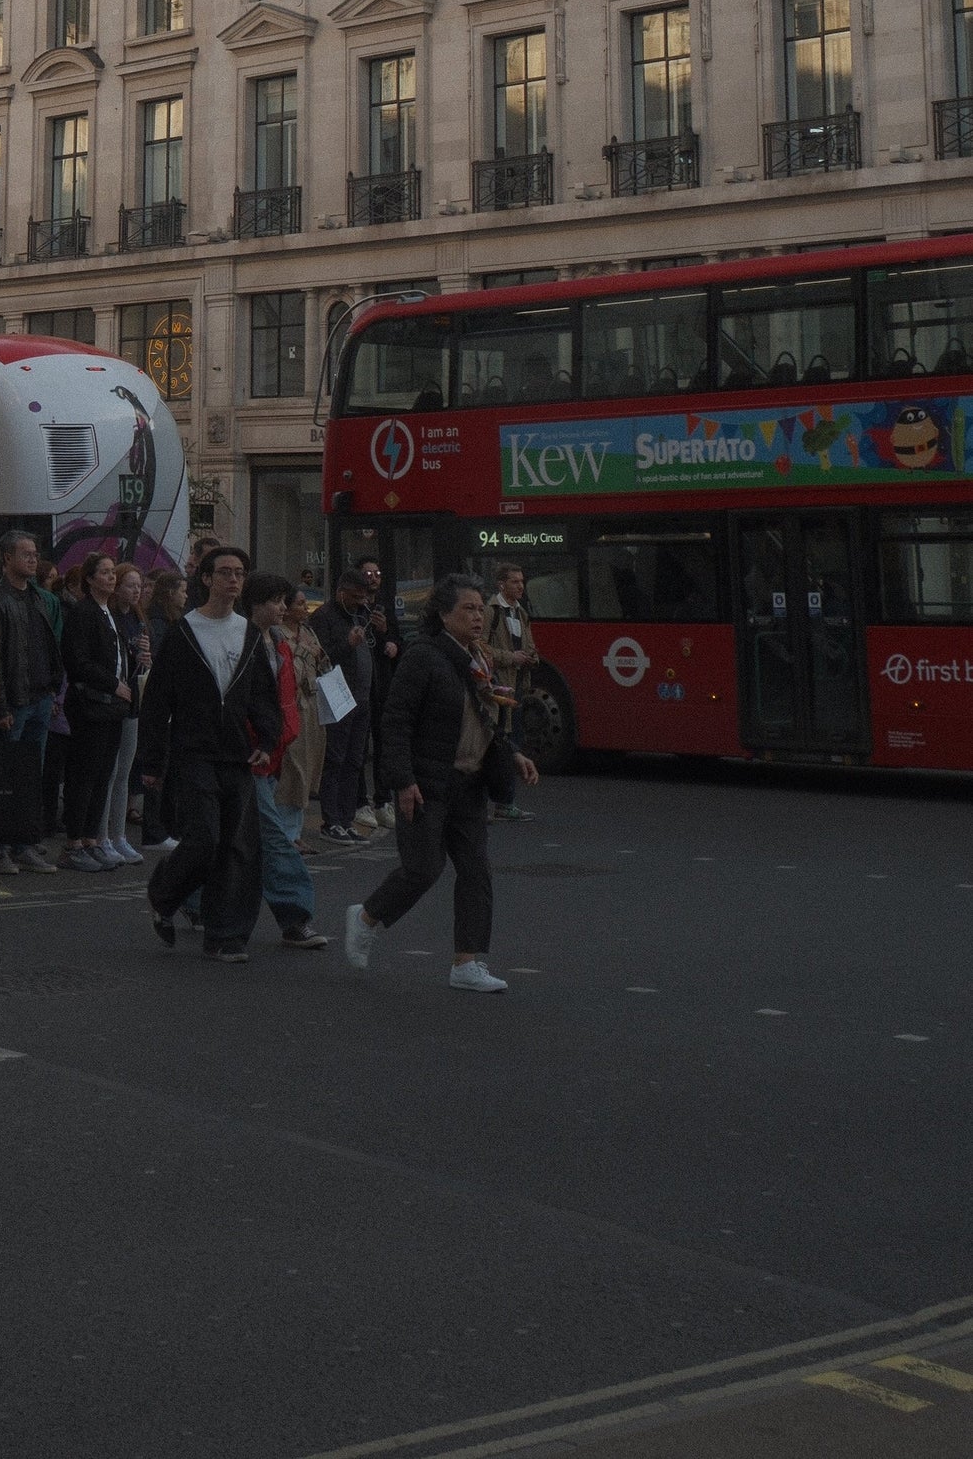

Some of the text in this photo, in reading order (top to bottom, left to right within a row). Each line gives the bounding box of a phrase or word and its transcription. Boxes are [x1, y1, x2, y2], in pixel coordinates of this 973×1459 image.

[427, 428, 443, 438] am
[446, 426, 459, 437] an
[422, 442, 461, 454] electric
[636, 433, 756, 469] SUPERTATO
[422, 459, 442, 470] bus
[508, 433, 613, 488] Kew
[120, 479, 145, 504] 159
[479, 531, 564, 547] 94 Piccadilly Circus
[916, 659, 961, 682] first
